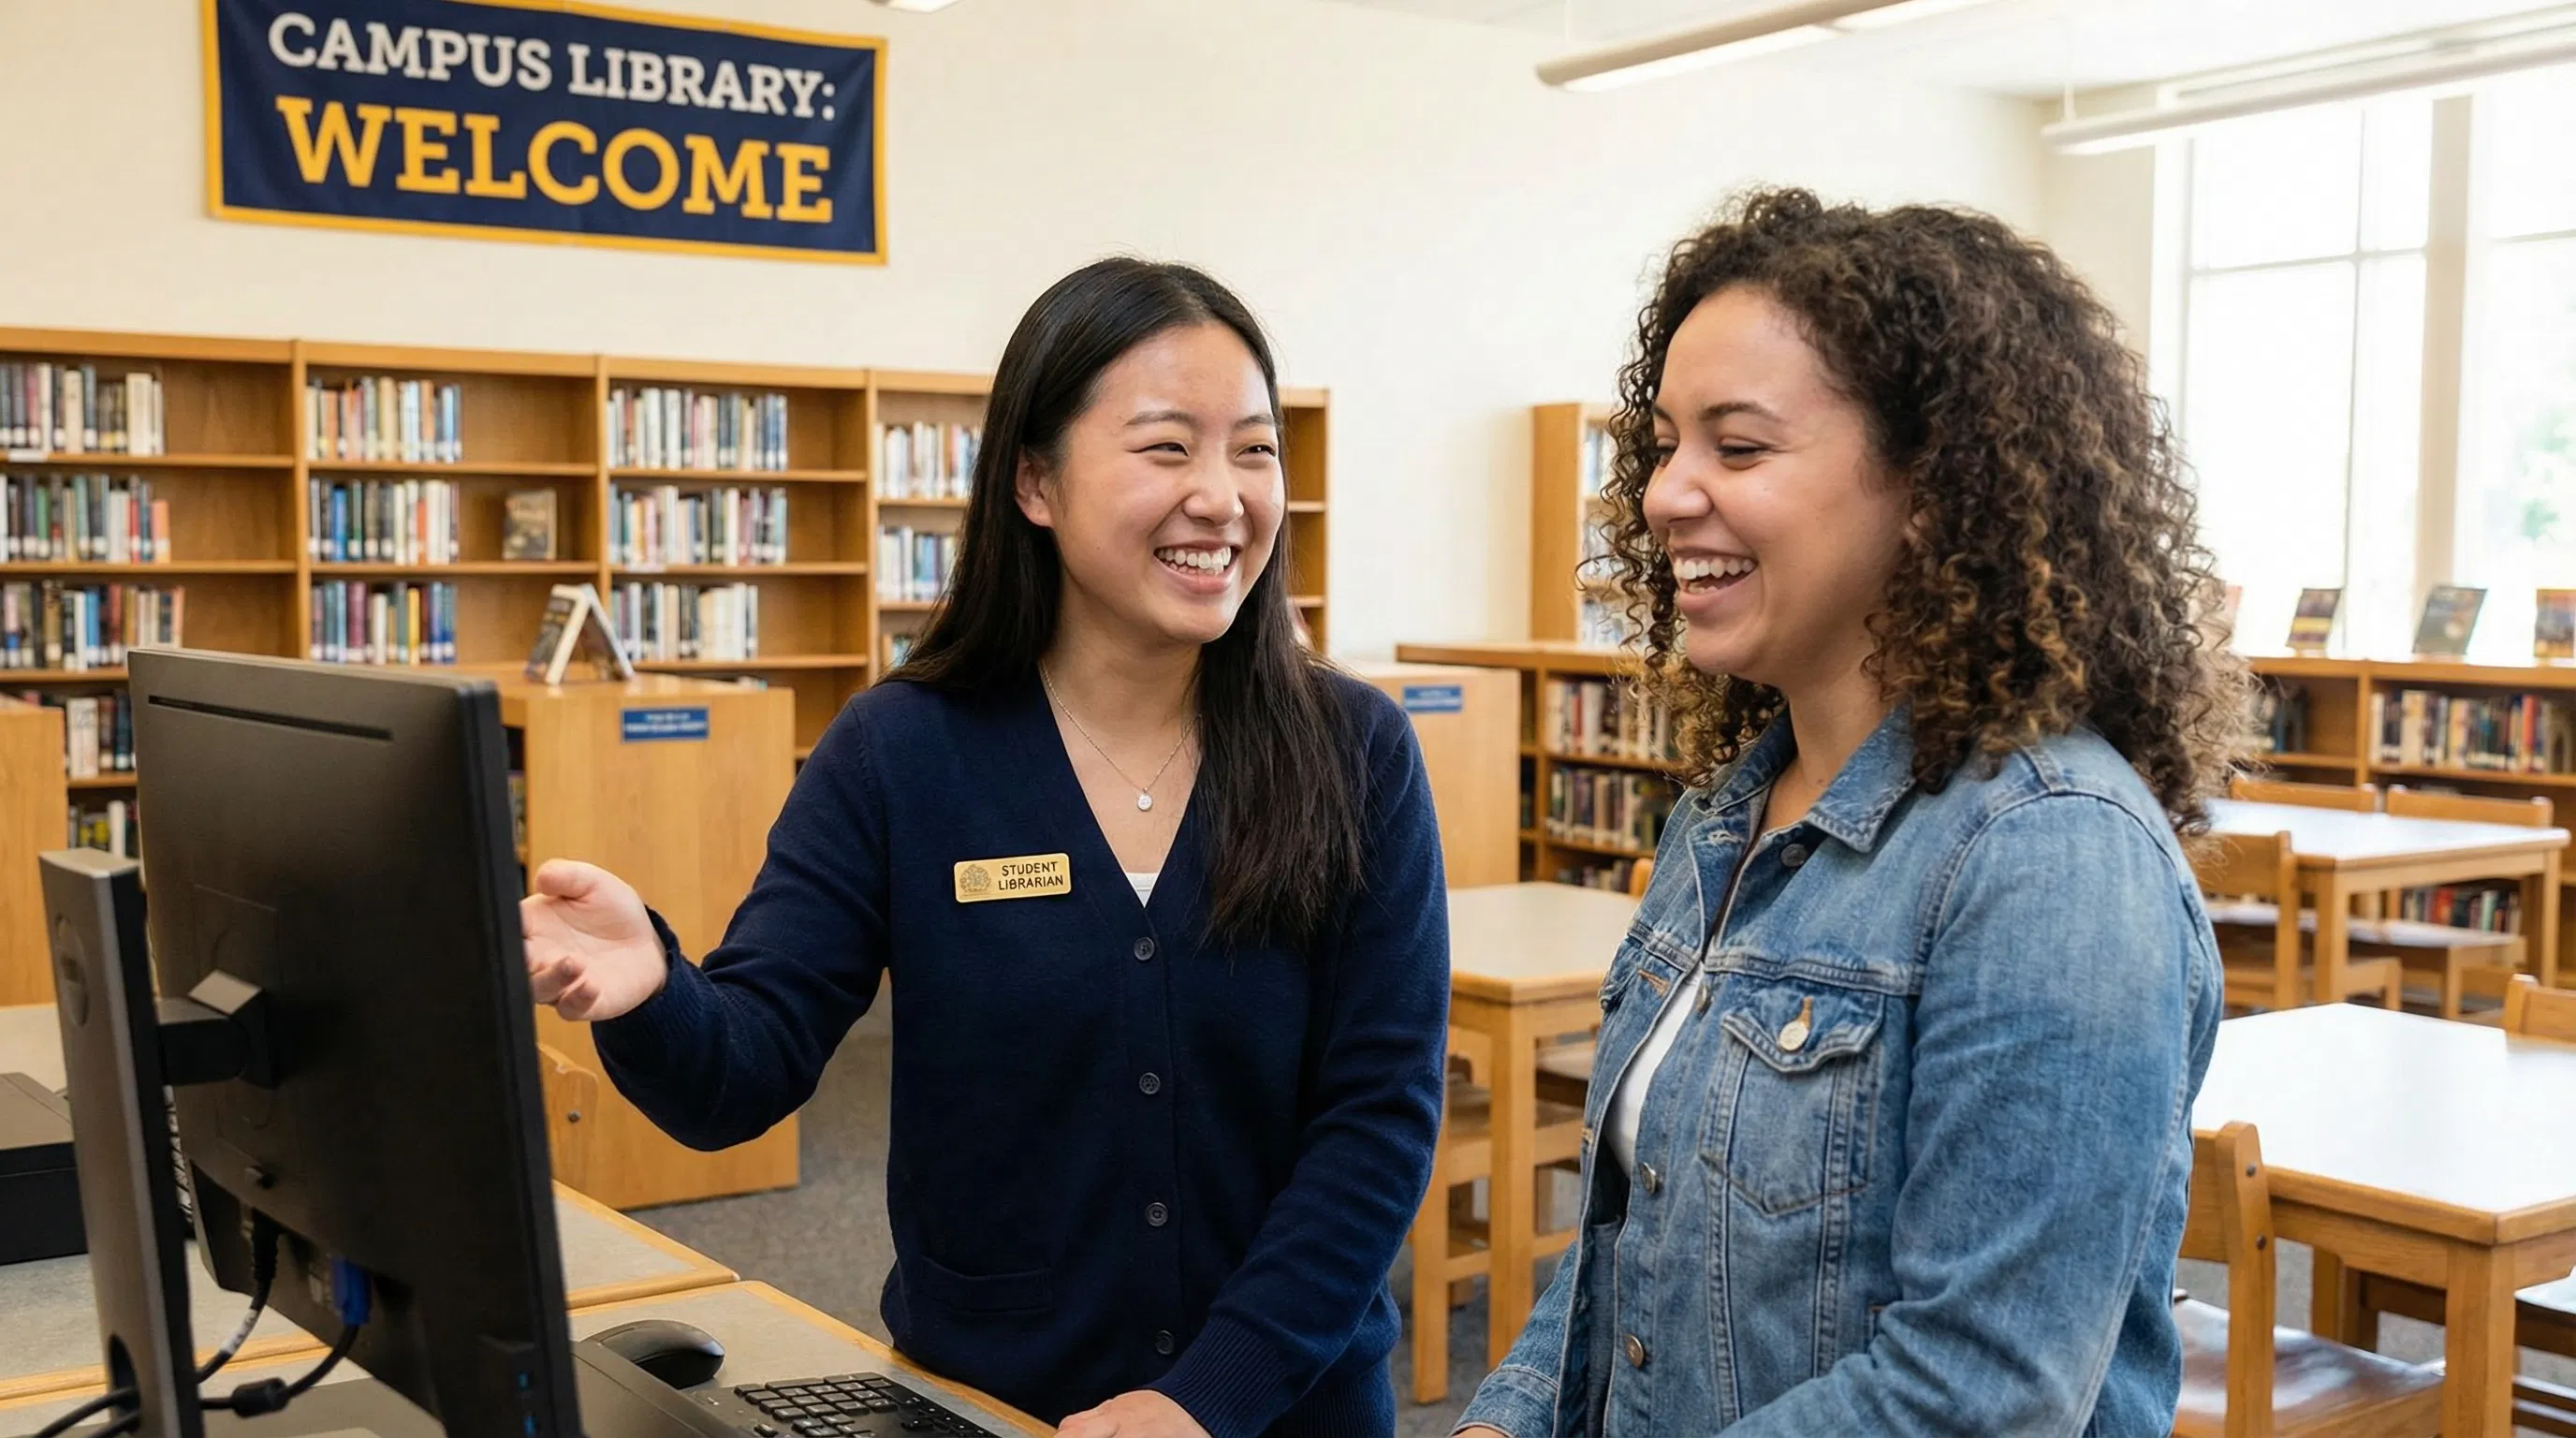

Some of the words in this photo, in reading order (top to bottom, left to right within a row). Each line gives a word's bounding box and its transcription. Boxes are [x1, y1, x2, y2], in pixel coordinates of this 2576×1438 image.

[268, 12, 553, 91] CAMPUS
[567, 43, 837, 122] LIBRARY:
[276, 95, 833, 224] WELCOME
[998, 875, 1063, 890] LIBRARIAN
[1002, 861, 1058, 876] STUDENT
